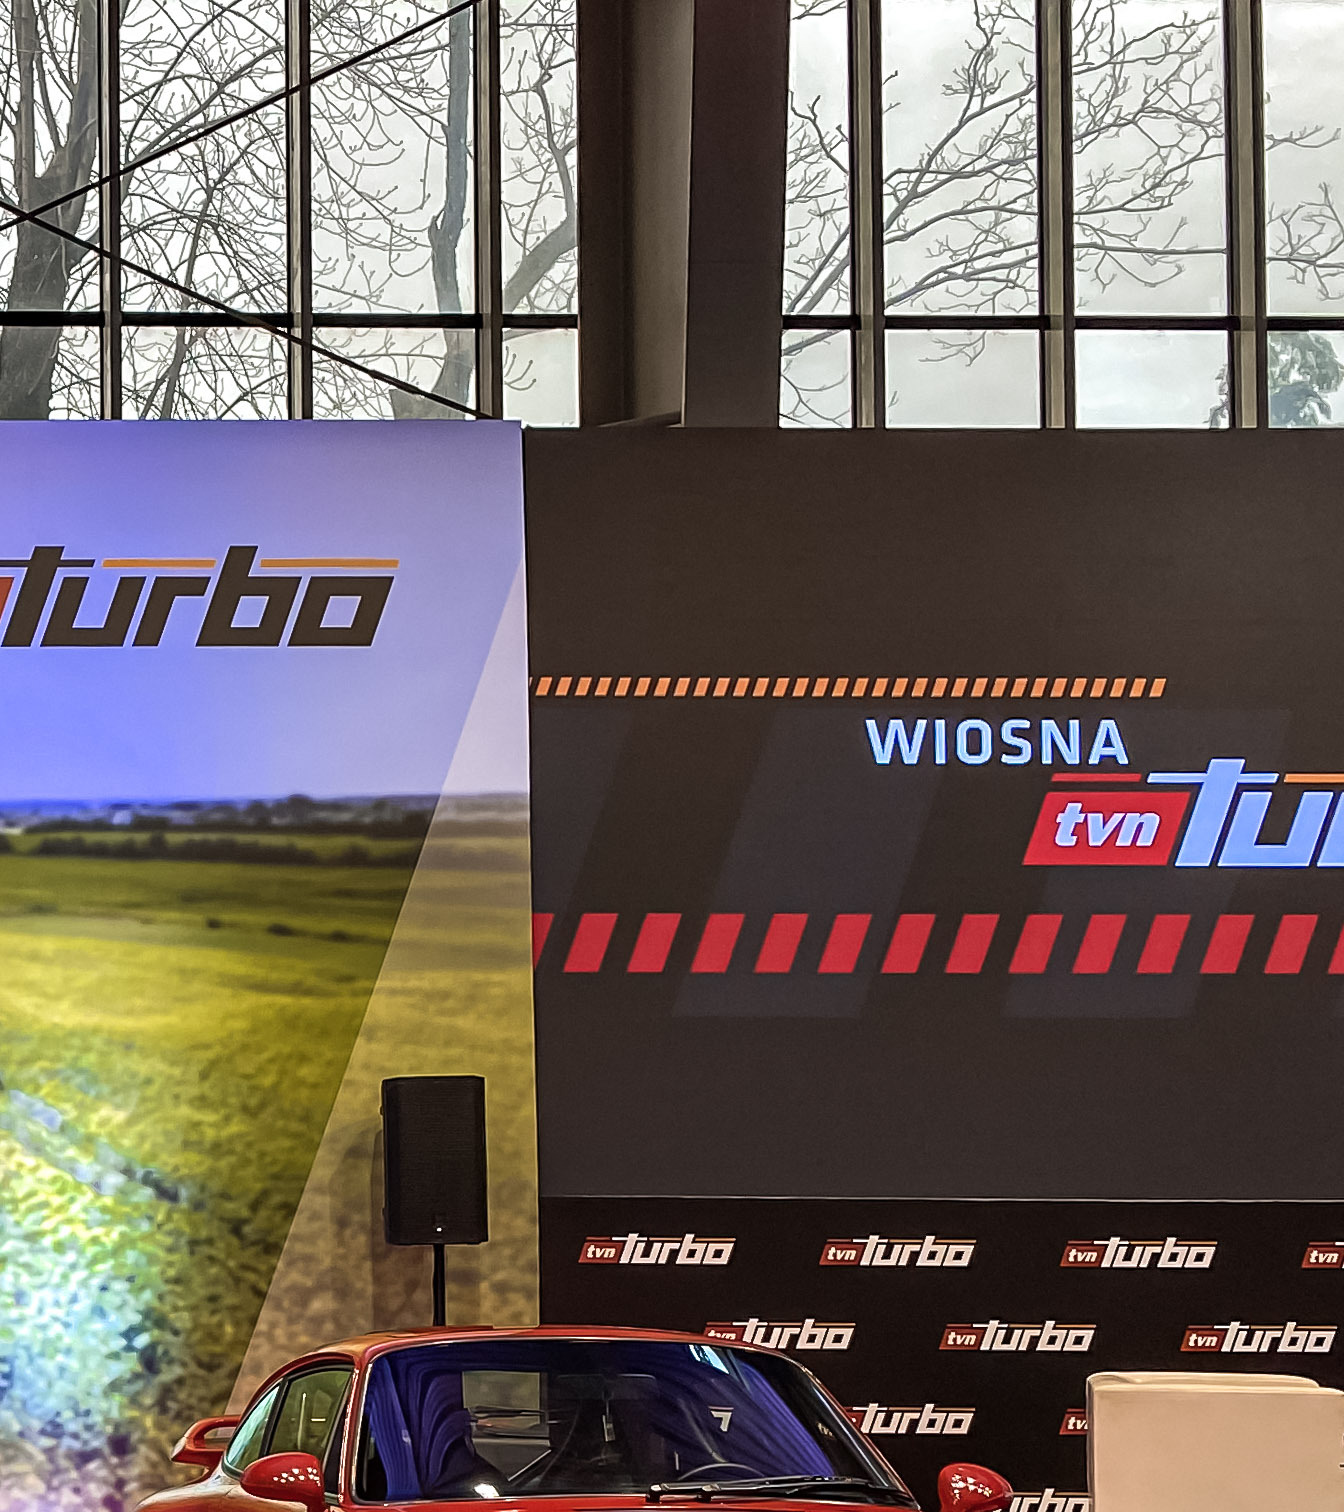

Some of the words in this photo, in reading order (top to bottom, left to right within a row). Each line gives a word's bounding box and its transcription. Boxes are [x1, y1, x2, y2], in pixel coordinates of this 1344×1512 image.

[864, 718, 1129, 766] WIOSNA
[1055, 802, 1161, 848] tvn
[587, 1245, 616, 1259] tvn
[613, 1233, 735, 1265] turbo
[827, 1247, 856, 1261] tvn
[853, 1235, 976, 1266] turbo
[1068, 1249, 1098, 1263] tvn
[1094, 1237, 1216, 1268] turbo
[1309, 1250, 1339, 1264] tvn
[733, 1318, 855, 1349] turbo
[947, 1331, 976, 1346] tvn
[973, 1320, 1096, 1351] turbo
[1188, 1333, 1217, 1347] tvn
[1214, 1321, 1337, 1353] turbo
[853, 1403, 975, 1435] turbo
